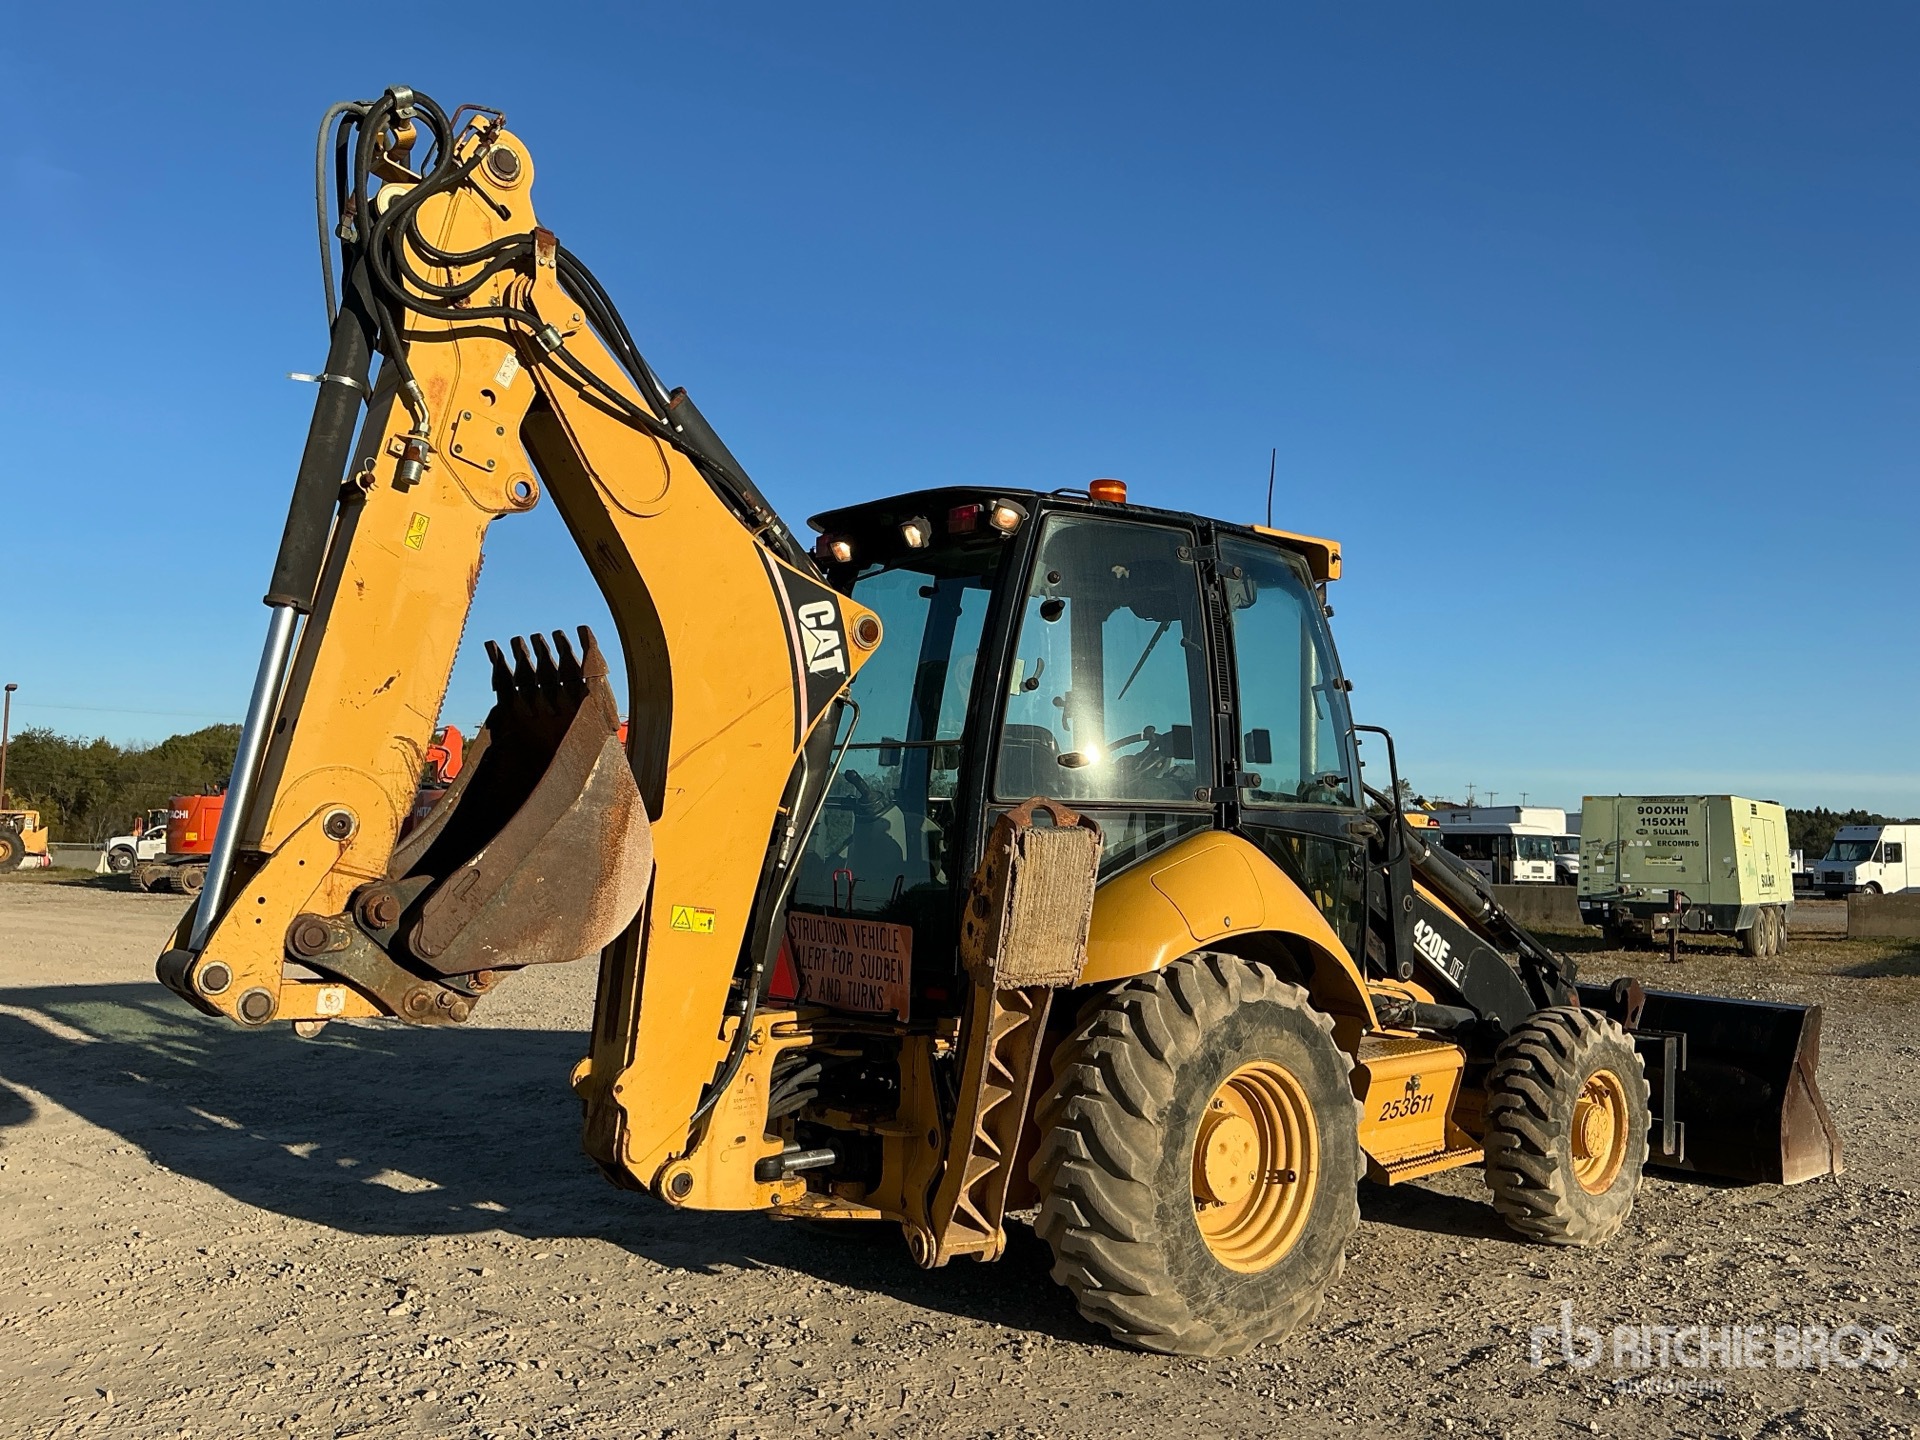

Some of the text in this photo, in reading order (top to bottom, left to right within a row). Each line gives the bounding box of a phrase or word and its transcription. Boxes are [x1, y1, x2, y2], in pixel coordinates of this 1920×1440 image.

[798, 600, 846, 674] CAT
[169, 809, 189, 819] ACHI
[1637, 806, 1689, 815] 900XHH
[1640, 817, 1686, 826] 1150XH
[1653, 828, 1690, 836] SULLAIR
[790, 916, 899, 954] STRUCTION VEHICLE
[1413, 918, 1451, 968] 420E
[832, 948, 854, 976] FOR
[818, 976, 841, 1002] AND
[847, 981, 884, 1011] TURNS
[1378, 1093, 1434, 1122] 253611
